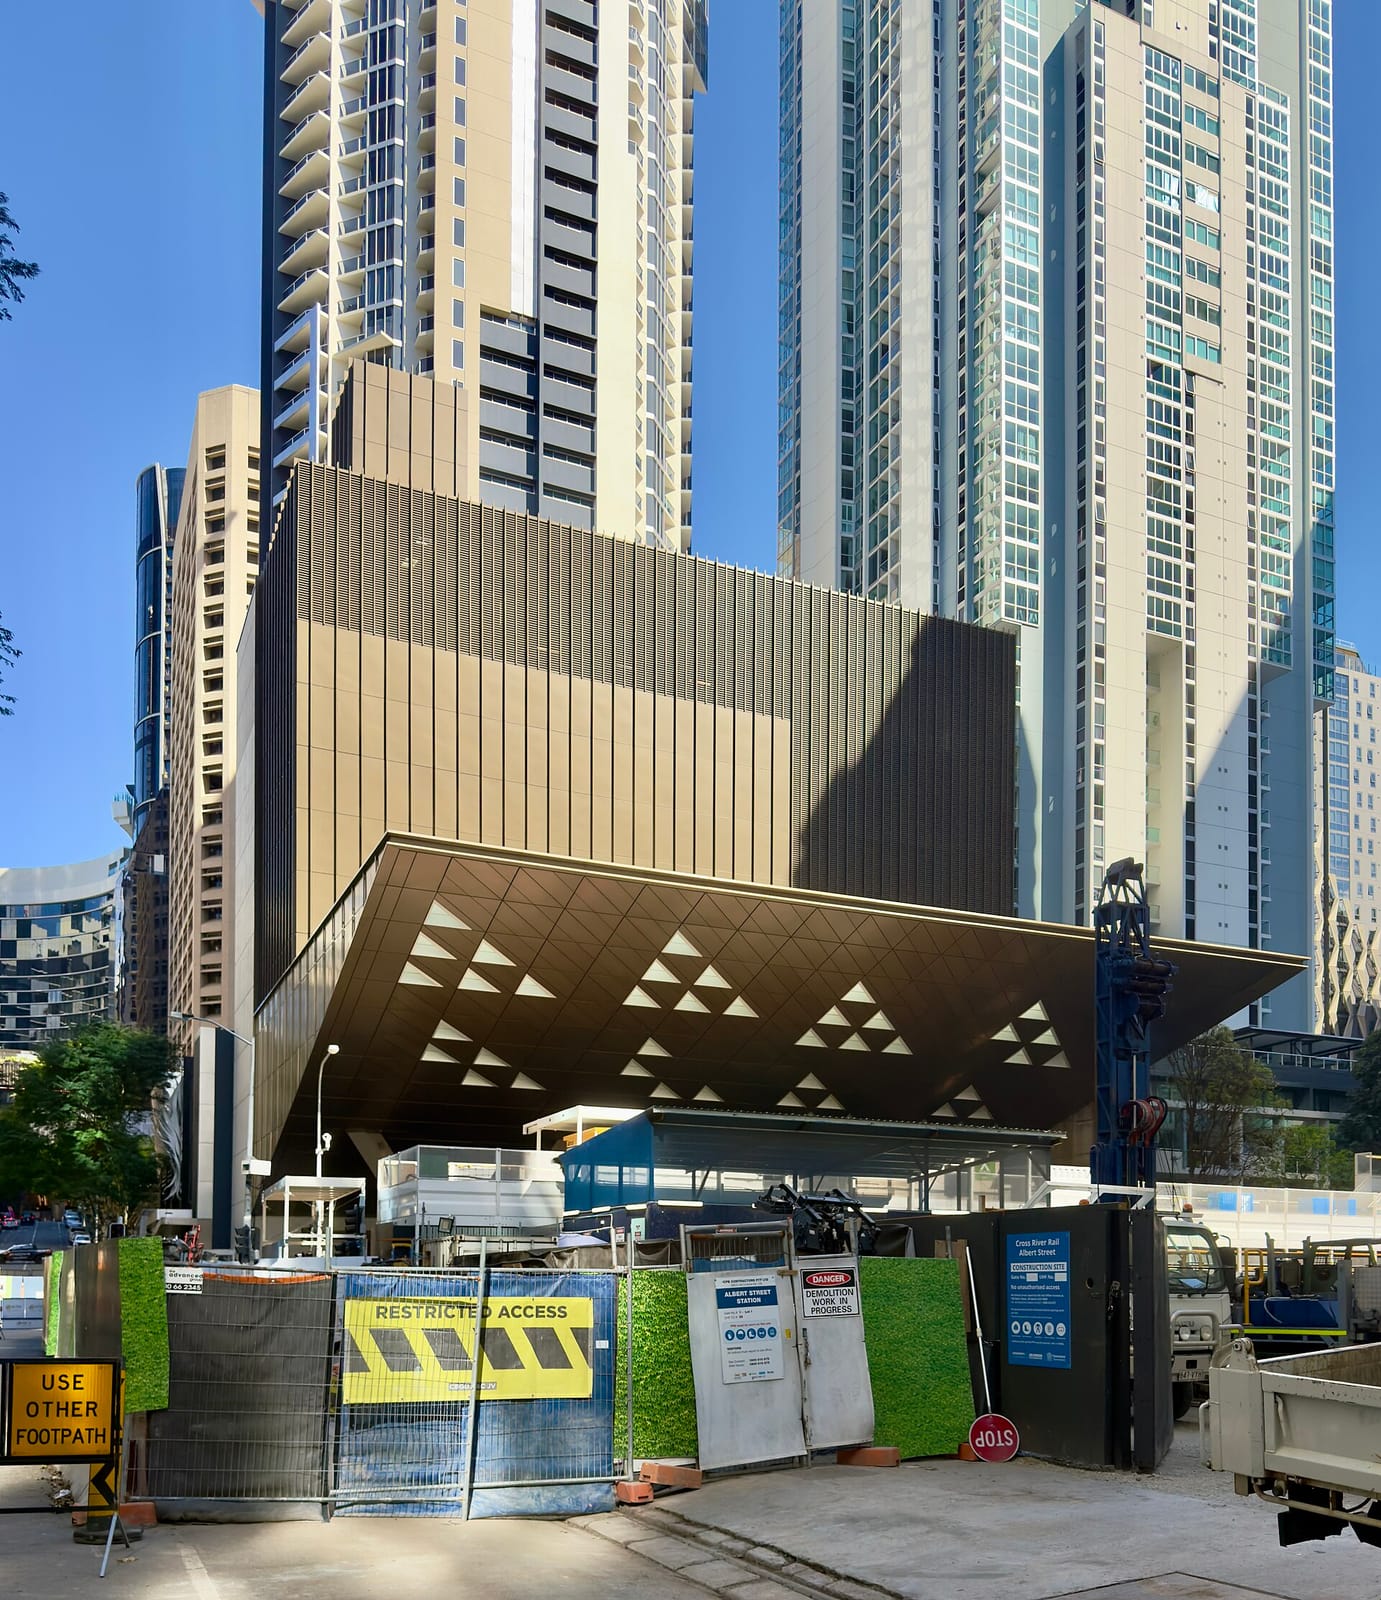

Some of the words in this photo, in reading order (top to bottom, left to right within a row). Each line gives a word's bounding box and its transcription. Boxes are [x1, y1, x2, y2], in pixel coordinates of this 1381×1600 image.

[1047, 1238, 1060, 1246] Rail
[1037, 1248, 1056, 1256] Street
[812, 1275, 846, 1283] DANGER
[805, 1288, 854, 1298] DEMOLITION
[812, 1298, 836, 1306] WORK
[376, 1305, 492, 1319] RESTRICTED
[498, 1305, 568, 1319] ACCESS
[810, 1305, 852, 1314] PROGRESS
[42, 1374, 84, 1391] USE
[26, 1401, 98, 1418] OTHER
[16, 1427, 106, 1445] FOOTPATH
[975, 1430, 1013, 1447] STOP
